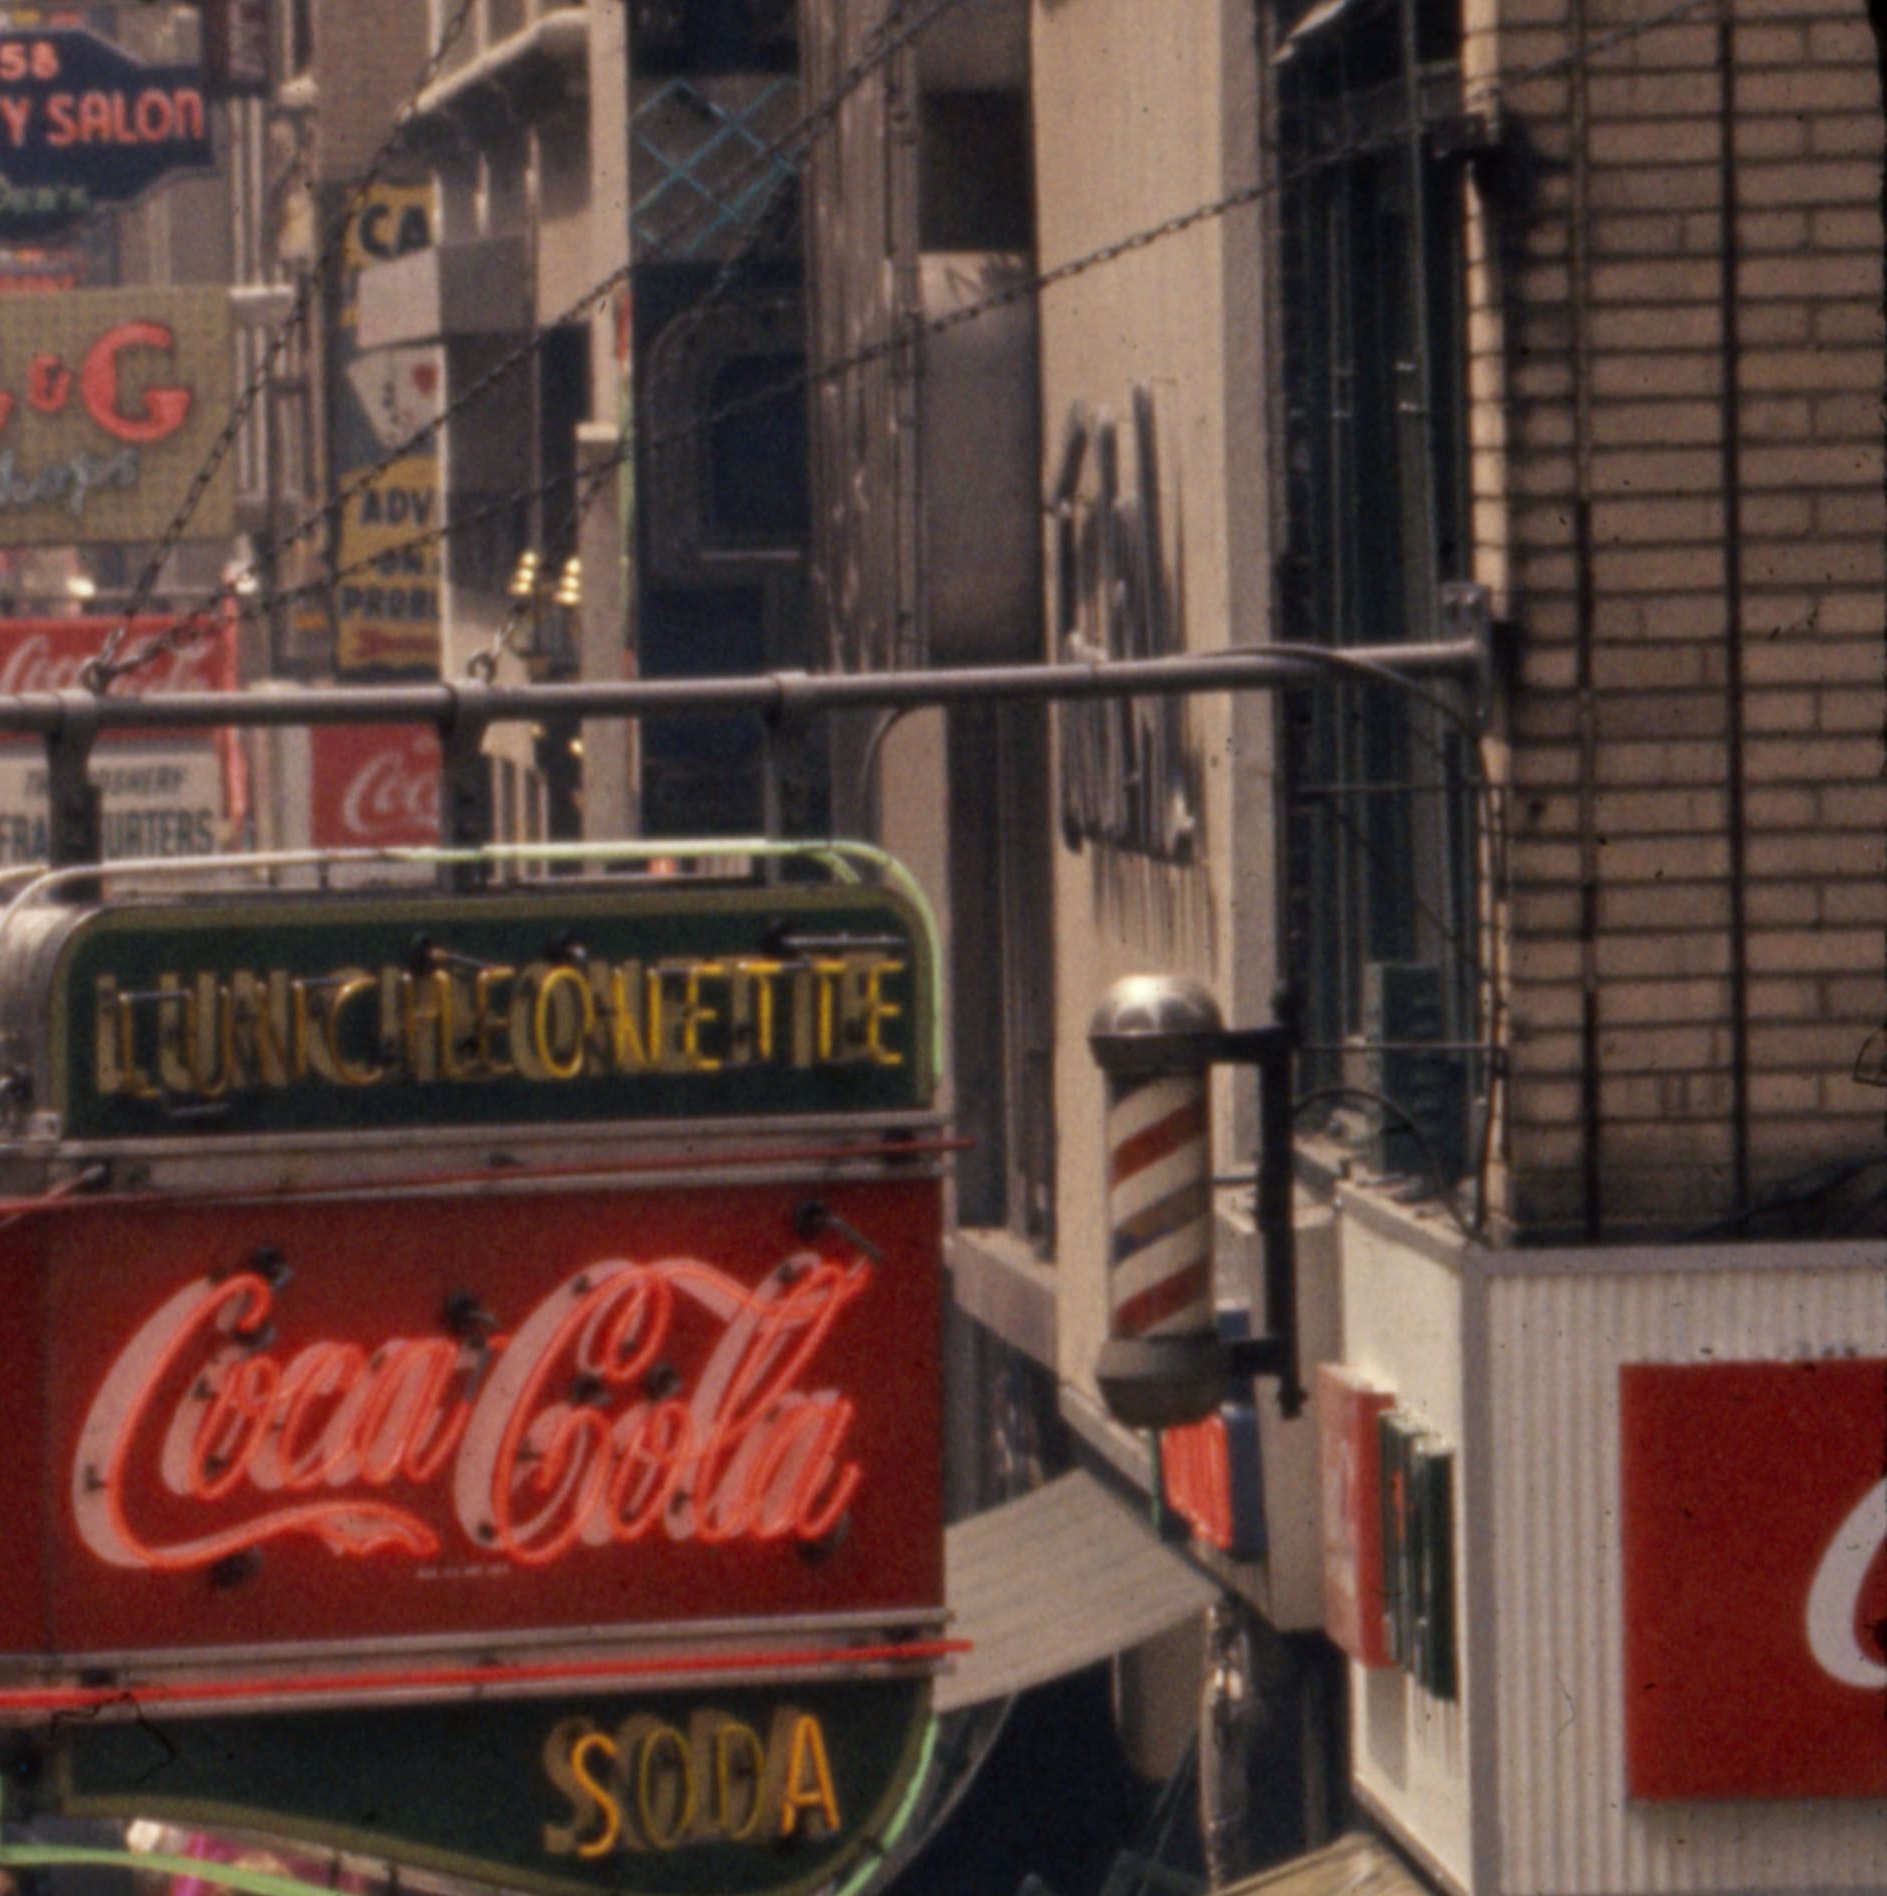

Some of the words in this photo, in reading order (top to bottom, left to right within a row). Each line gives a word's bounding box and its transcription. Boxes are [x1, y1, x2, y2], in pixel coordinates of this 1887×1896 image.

[46, 88, 205, 148] SALON
[96, 962, 906, 1098] LUNCHEONETTE
[71, 1252, 875, 1569] Coca-Cola
[542, 1706, 840, 1858] SODA
